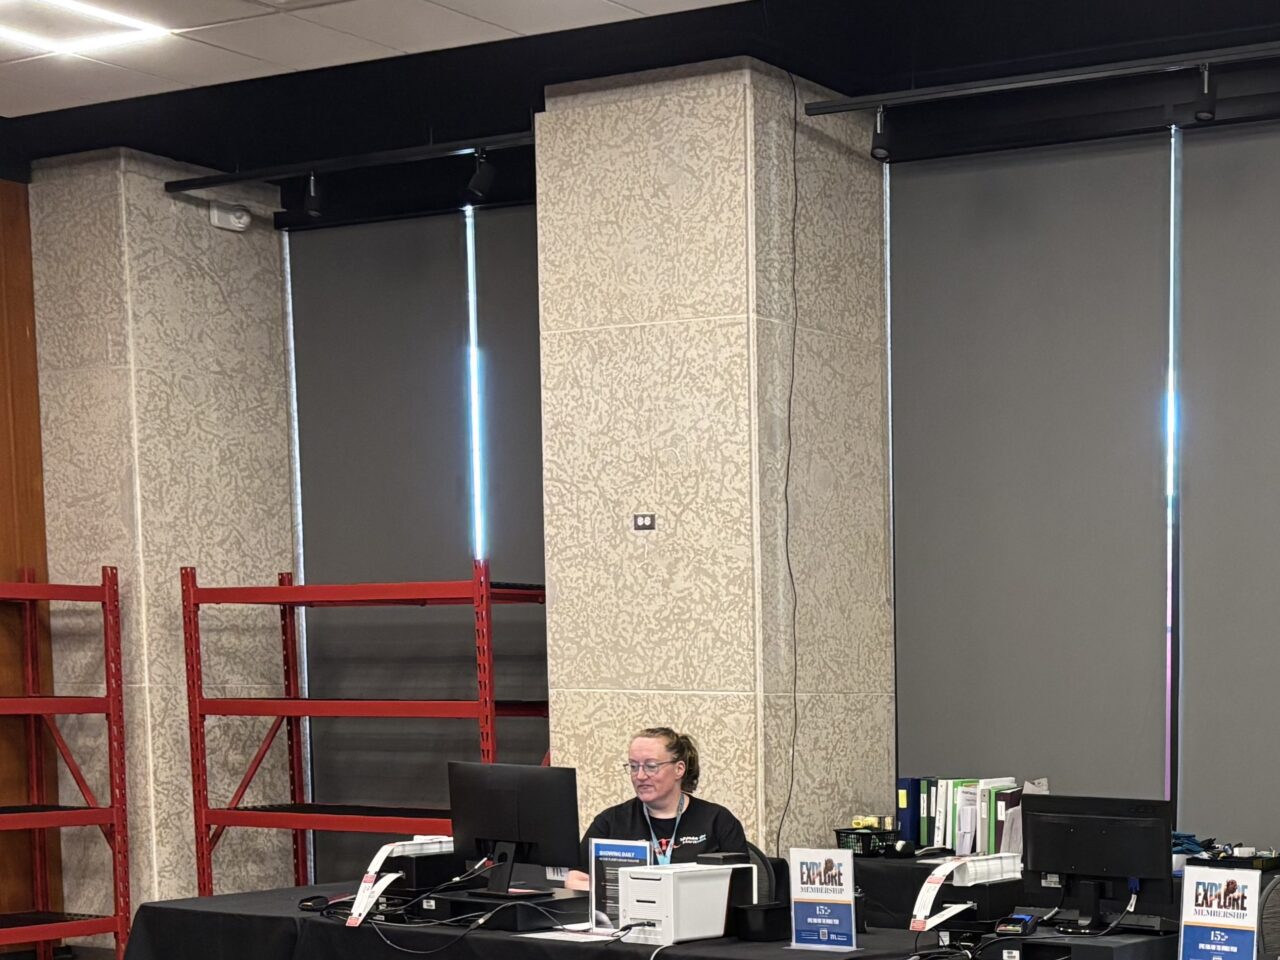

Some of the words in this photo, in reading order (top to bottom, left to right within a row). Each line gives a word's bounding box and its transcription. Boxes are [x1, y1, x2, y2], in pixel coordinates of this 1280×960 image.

[799, 860, 844, 887] EXPLORE
[799, 886, 844, 895] MEMBERSHIP
[1194, 881, 1249, 911] EXPLORE
[1193, 908, 1248, 920] MEMBERSHIP
